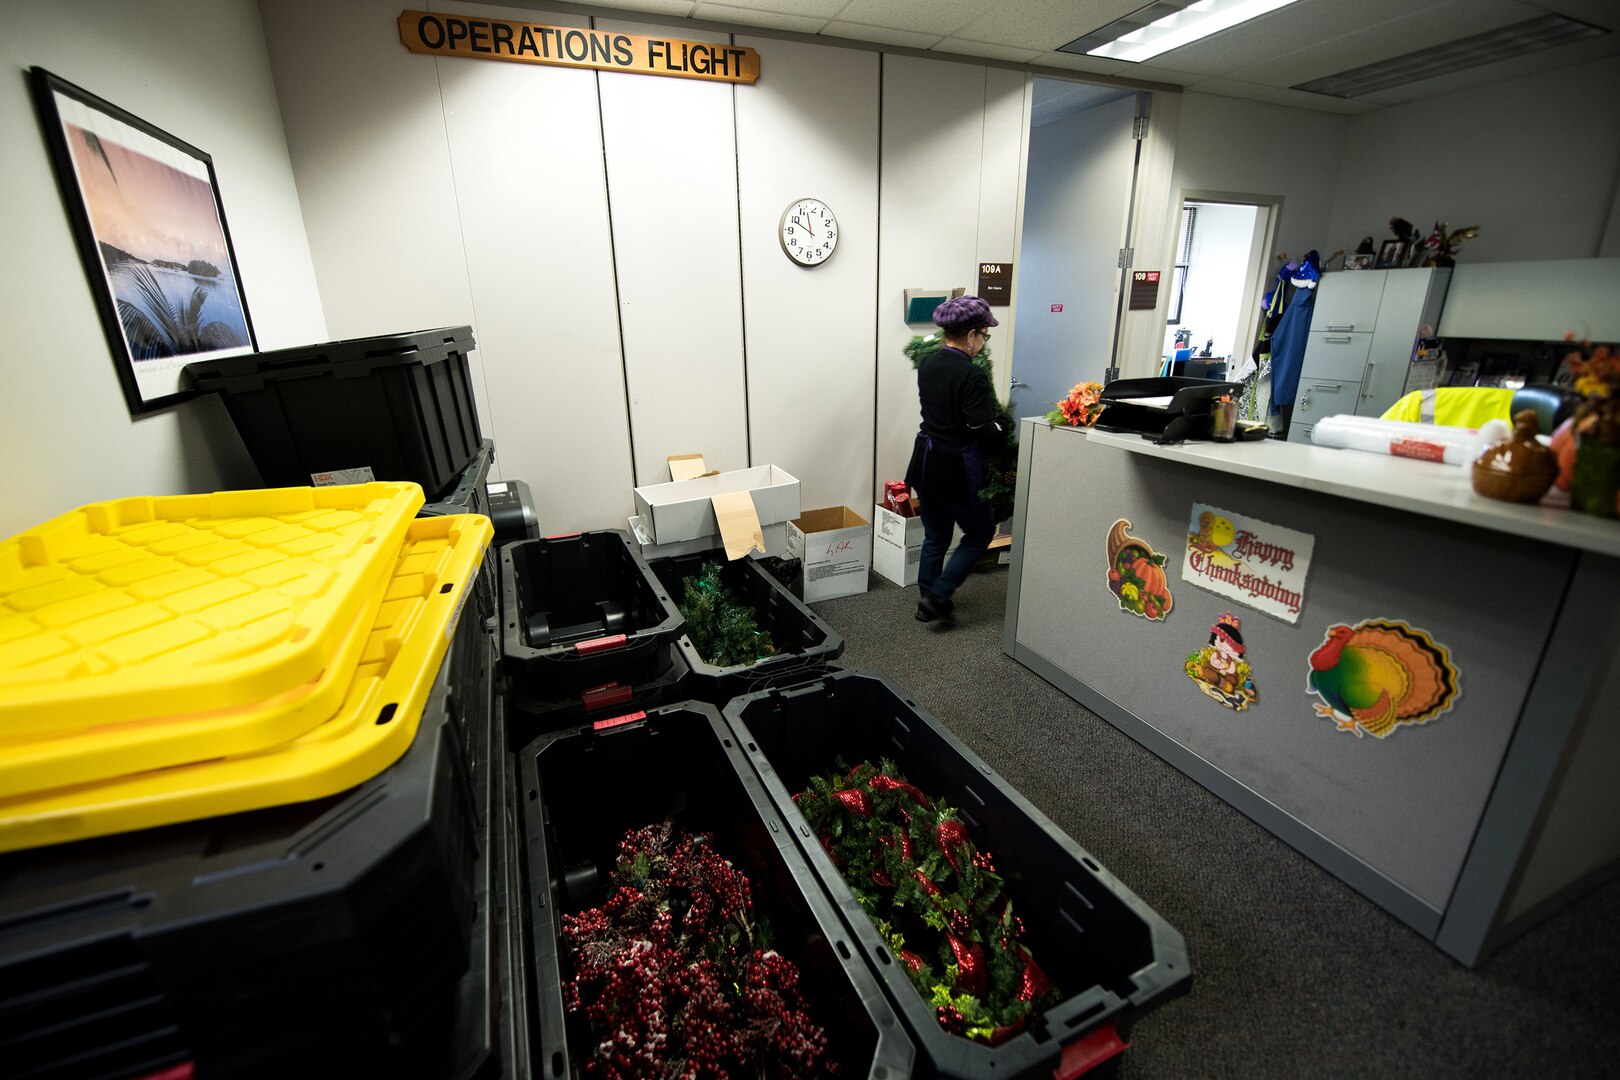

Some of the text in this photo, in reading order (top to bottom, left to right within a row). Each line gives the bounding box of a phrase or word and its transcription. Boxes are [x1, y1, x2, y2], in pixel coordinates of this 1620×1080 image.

[417, 15, 747, 78] OPERATIONS FLIGHT
[820, 210, 824, 218] 1
[791, 215, 801, 224] 10
[824, 218, 831, 228] 2
[787, 226, 794, 235] 9
[826, 230, 833, 239] 3
[790, 237, 797, 246] 8
[822, 241, 829, 249] 4
[797, 246, 804, 255] 7
[806, 250, 813, 259] 6
[815, 248, 822, 257] 5
[981, 264, 1002, 274] 109A
[1134, 272, 1147, 281] 109
[314, 473, 333, 481] HDX
[1231, 529, 1295, 573] Happy
[1187, 543, 1302, 614] Thanksgiving
